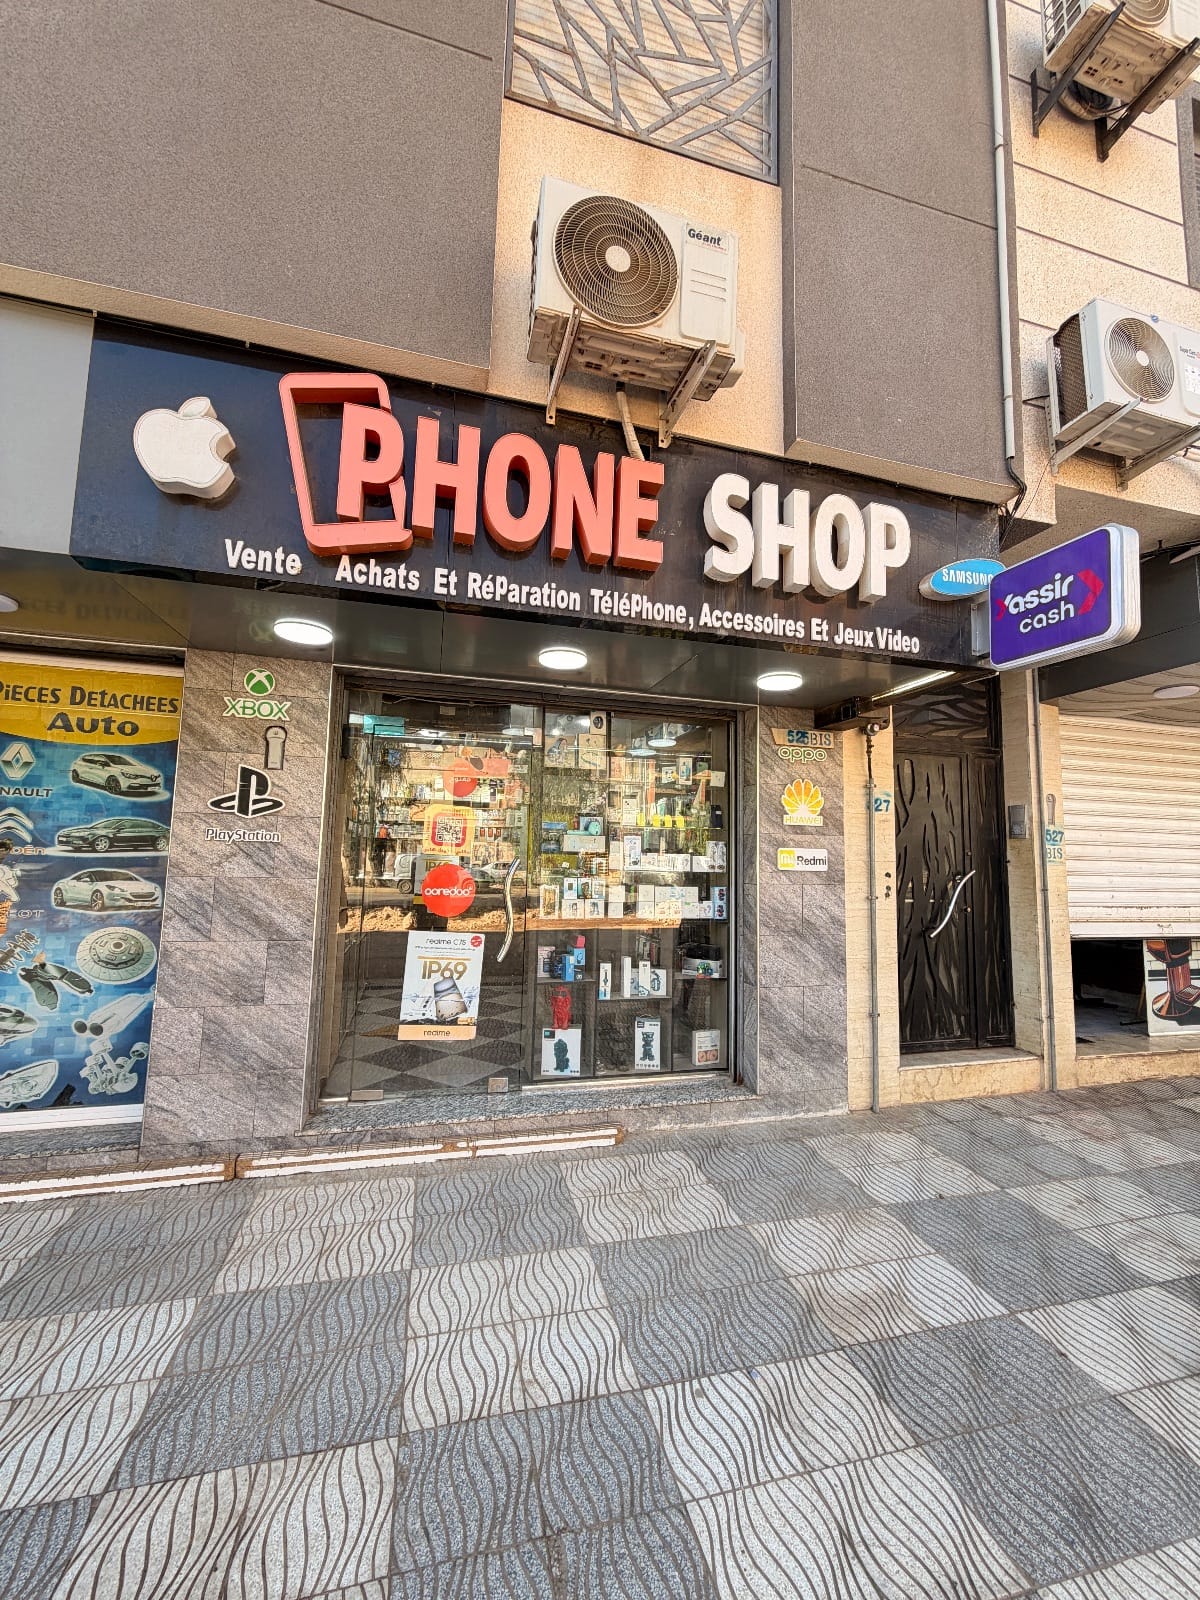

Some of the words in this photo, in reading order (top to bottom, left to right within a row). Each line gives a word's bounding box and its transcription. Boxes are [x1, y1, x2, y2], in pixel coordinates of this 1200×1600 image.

[688, 228, 722, 246] Géant
[336, 401, 666, 573] PHONE
[703, 472, 912, 603] SHOP
[224, 538, 303, 576] Vente
[334, 554, 420, 592] Achats
[433, 567, 458, 596] Et
[699, 602, 805, 639] Accessoires
[810, 617, 829, 642] Et
[833, 622, 874, 648] Jeux
[875, 626, 920, 654] Video
[1019, 600, 1075, 634] cash
[224, 698, 290, 720] XBOX
[779, 747, 826, 763] oppo
[784, 815, 823, 825] HUAWEI
[205, 828, 281, 843] PlayStation
[1045, 829, 1064, 843] 527
[796, 855, 827, 866] Redmi
[424, 886, 471, 897] ooredoo
[421, 960, 468, 980] IP69
[423, 1029, 451, 1037] realme
